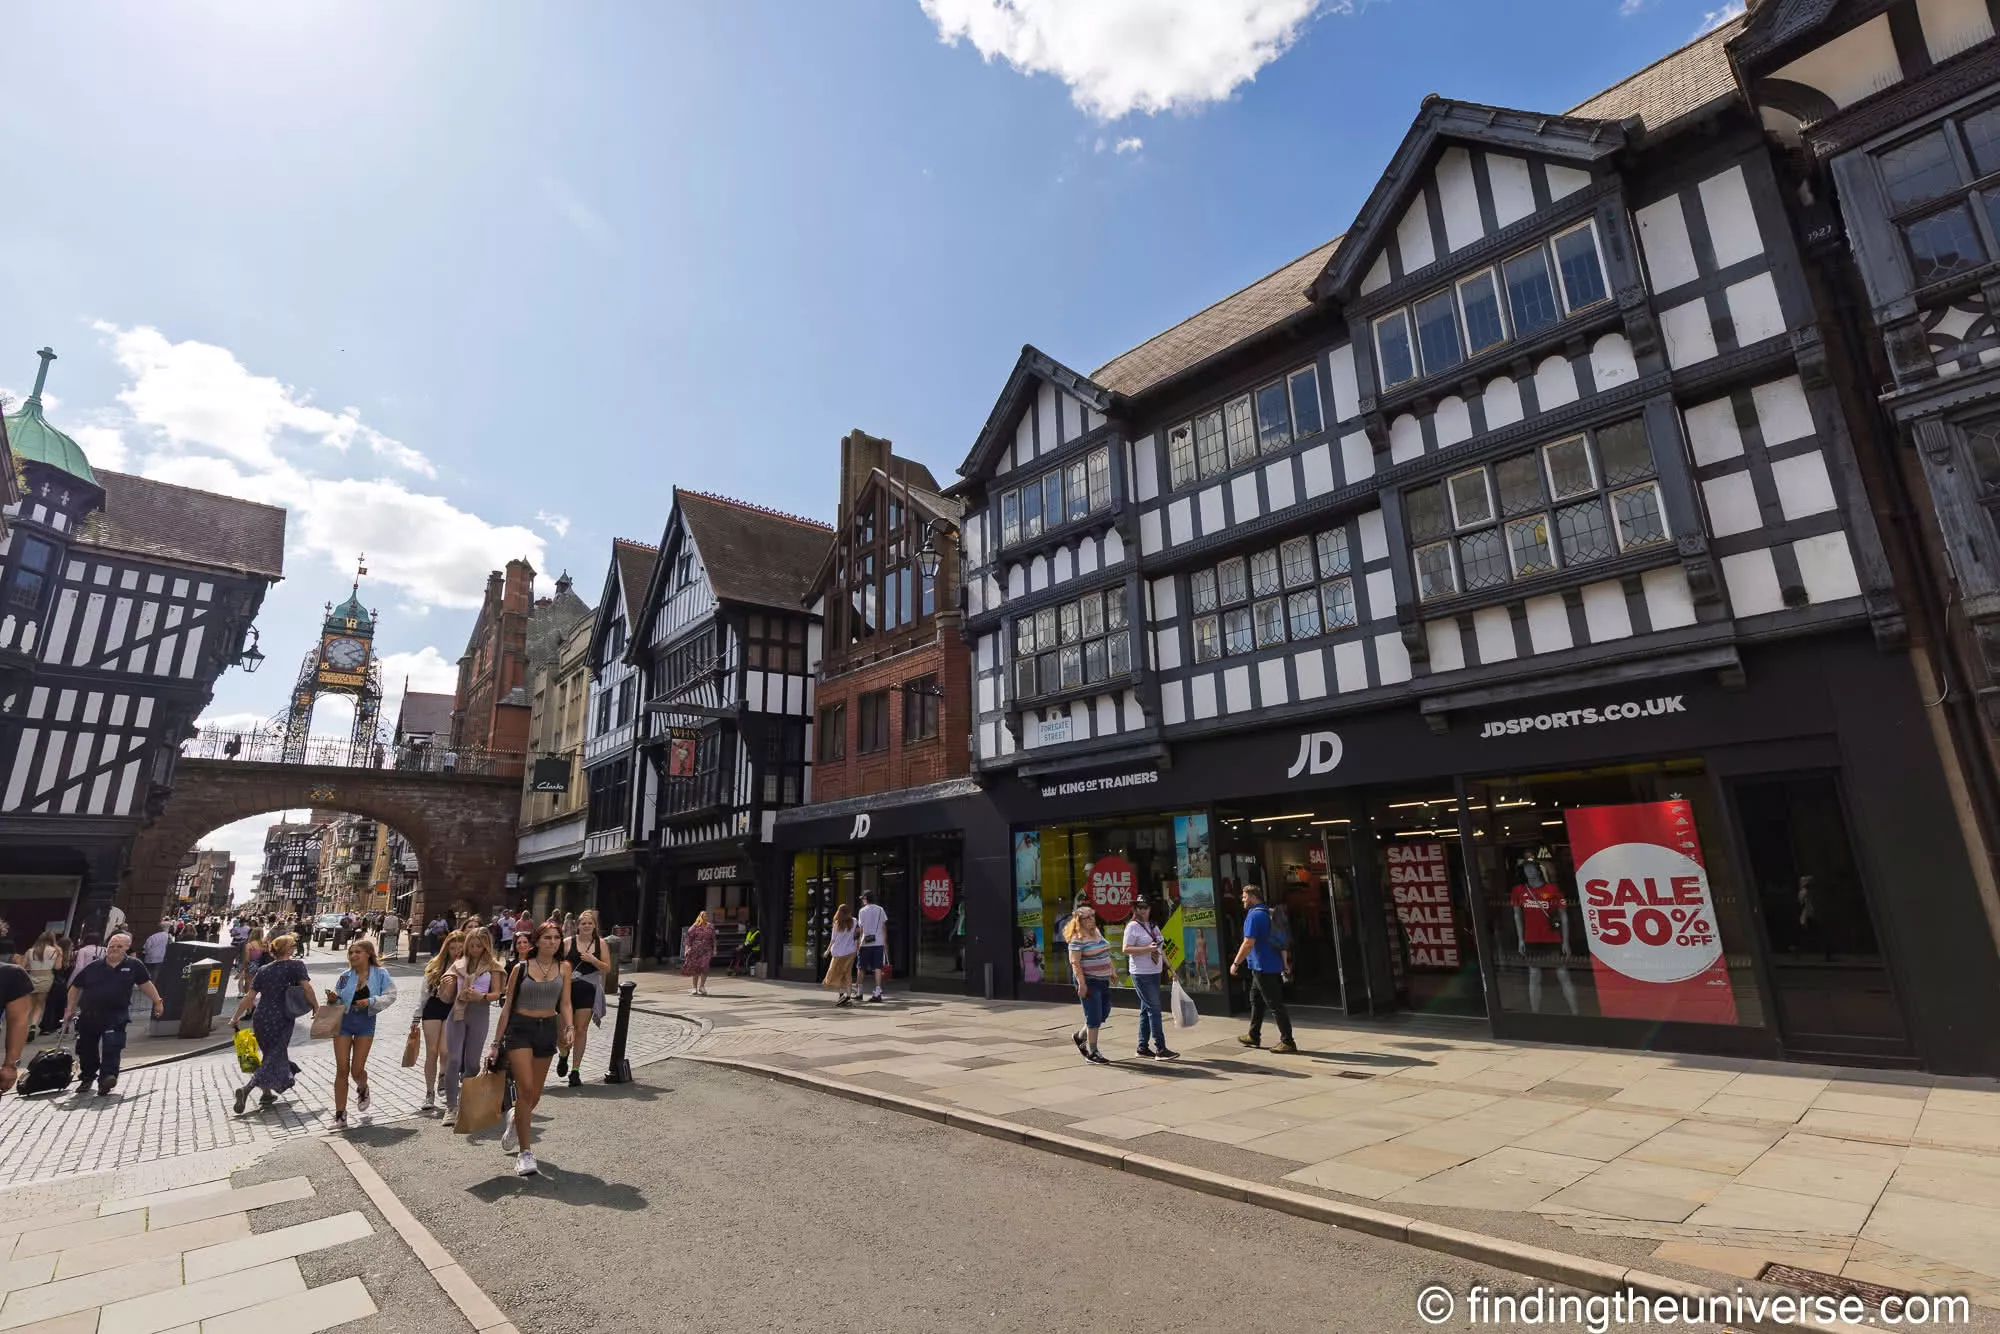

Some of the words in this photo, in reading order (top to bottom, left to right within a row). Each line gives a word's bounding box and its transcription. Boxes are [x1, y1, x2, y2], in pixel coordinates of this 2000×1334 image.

[1480, 695, 1686, 738] JDSPORTS.CO.UK
[1041, 720, 1070, 732] FOREGATE
[1044, 731, 1065, 742] STREET
[1287, 731, 1343, 778] JD
[537, 781, 564, 790] Clarks
[1059, 782, 1085, 795] KING
[1086, 780, 1098, 791] OF
[1098, 771, 1158, 789] TRAINERS
[849, 813, 871, 840] JD
[1387, 845, 1443, 863] SALE
[697, 868, 713, 880] POST
[713, 865, 736, 879] OFFICE
[1093, 872, 1131, 886] SALE
[1390, 865, 1447, 882] SALE
[924, 880, 949, 891] SALE
[1584, 876, 1704, 907] SALE
[1096, 887, 1131, 904] 50%
[1393, 886, 1450, 903] SALE
[1397, 907, 1452, 923] SALE
[1588, 909, 1596, 921] TO
[1591, 922, 1599, 936] UP
[1598, 908, 1710, 947] 50%
